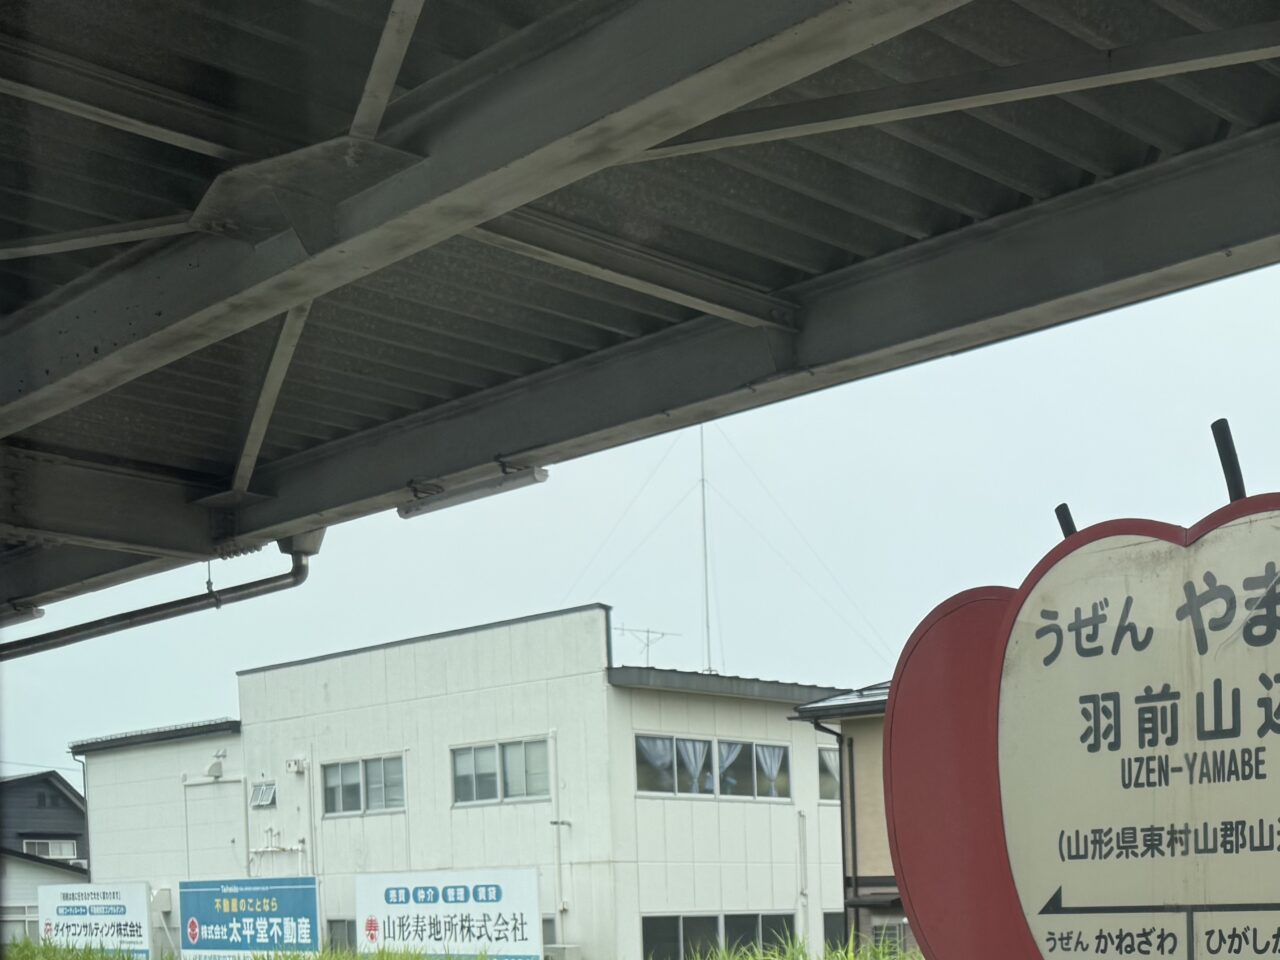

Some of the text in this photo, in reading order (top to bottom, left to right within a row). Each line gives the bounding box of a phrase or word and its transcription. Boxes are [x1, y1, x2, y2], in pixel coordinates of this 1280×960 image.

[1034, 596, 1154, 667] うぜん
[1121, 746, 1267, 789] UZEN-YAMABE
[214, 897, 278, 913] 不動産のことなら
[54, 921, 143, 938] ダイヤコンサルティング株式会社
[383, 912, 529, 943] 山形寿地所株式会社
[1045, 927, 1178, 956] うぜん かねざわ
